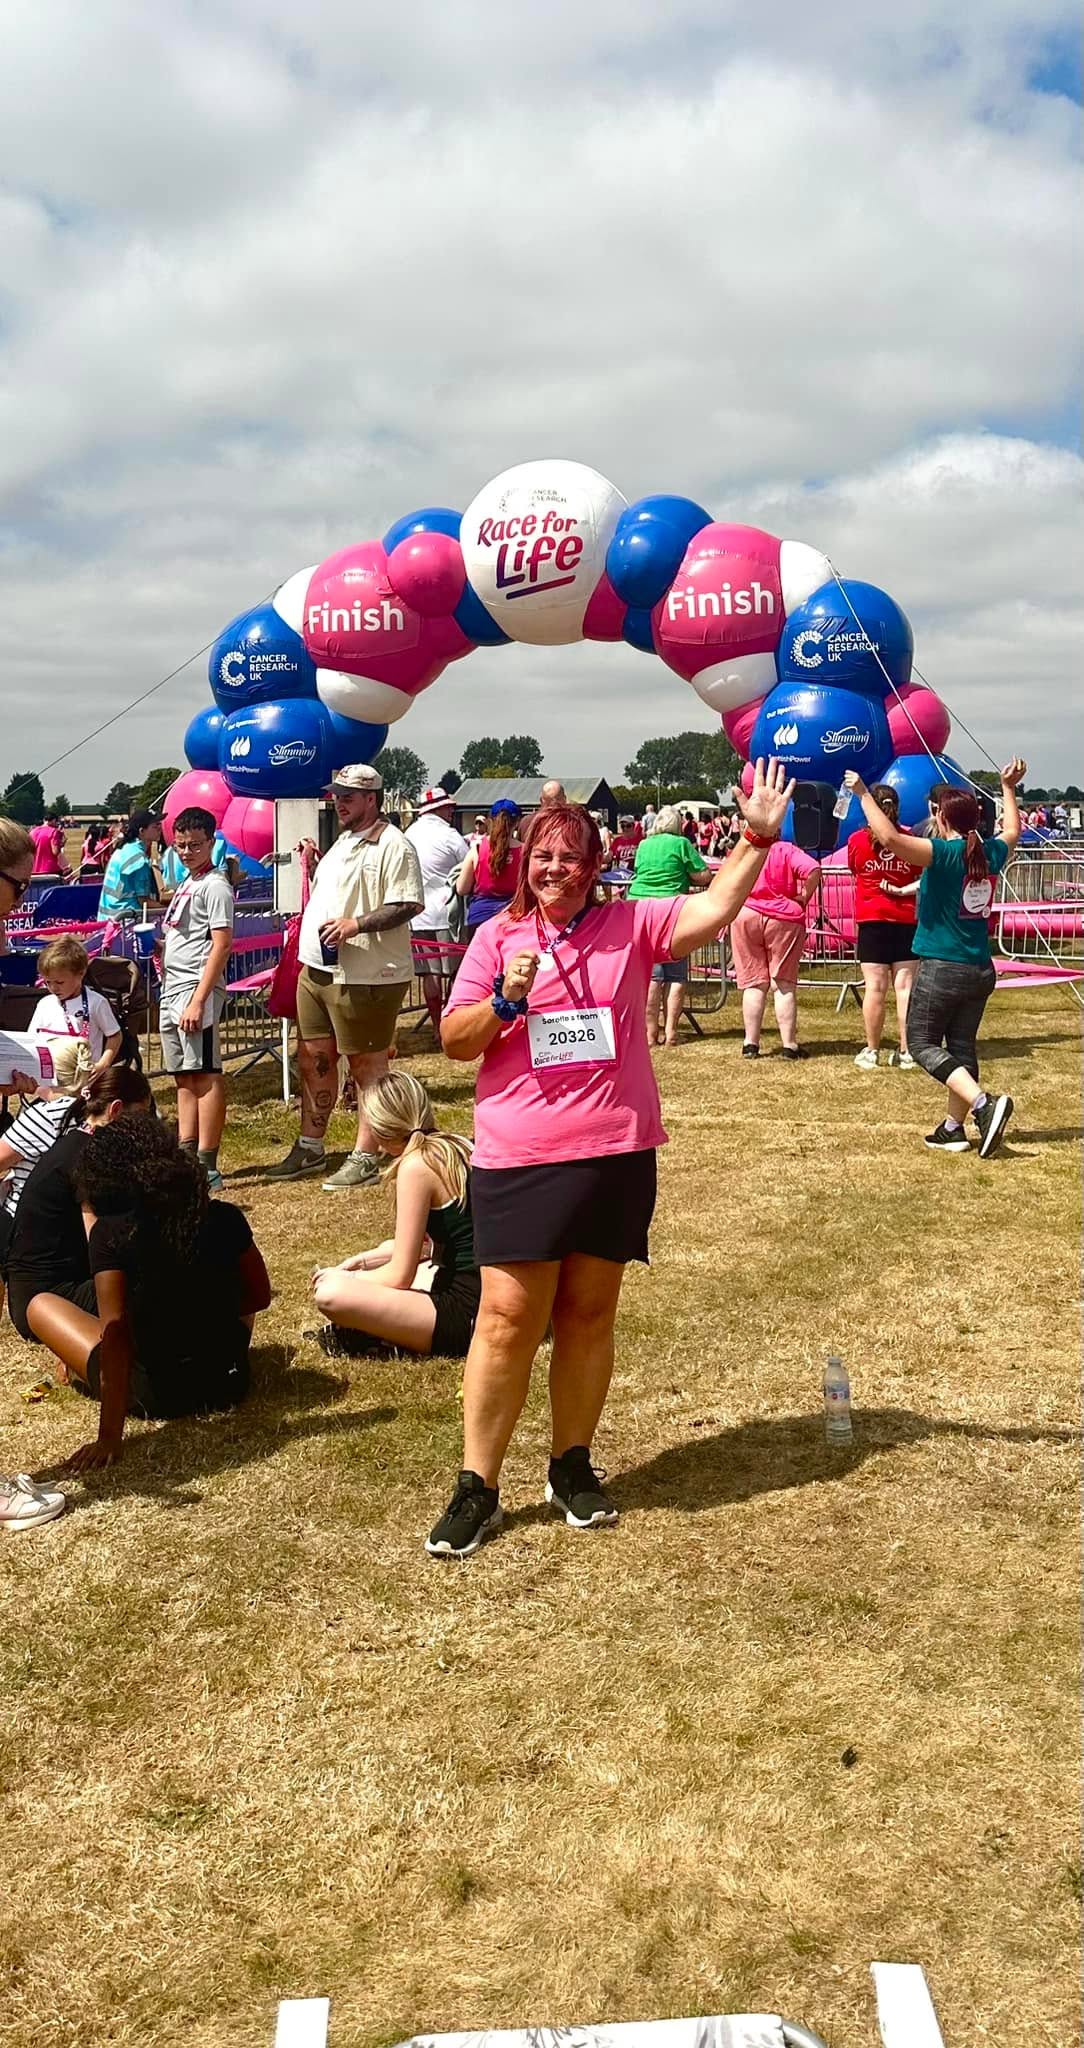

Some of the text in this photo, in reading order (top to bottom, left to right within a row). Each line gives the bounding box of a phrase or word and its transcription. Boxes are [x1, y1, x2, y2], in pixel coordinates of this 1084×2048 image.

[477, 511, 577, 547] Race for
[496, 536, 583, 589] Life
[667, 582, 774, 621] Finish
[307, 601, 404, 634] Finish
[826, 633, 868, 643] CANCER
[827, 642, 879, 652] RESEARCH
[249, 654, 287, 663] CANCER
[828, 653, 842, 662] UK
[249, 663, 298, 672] RESEARCH
[820, 729, 870, 747] Slimming
[268, 742, 317, 760] Slimming
[864, 860, 911, 874] SMILES
[548, 1028, 596, 1046] 20326
